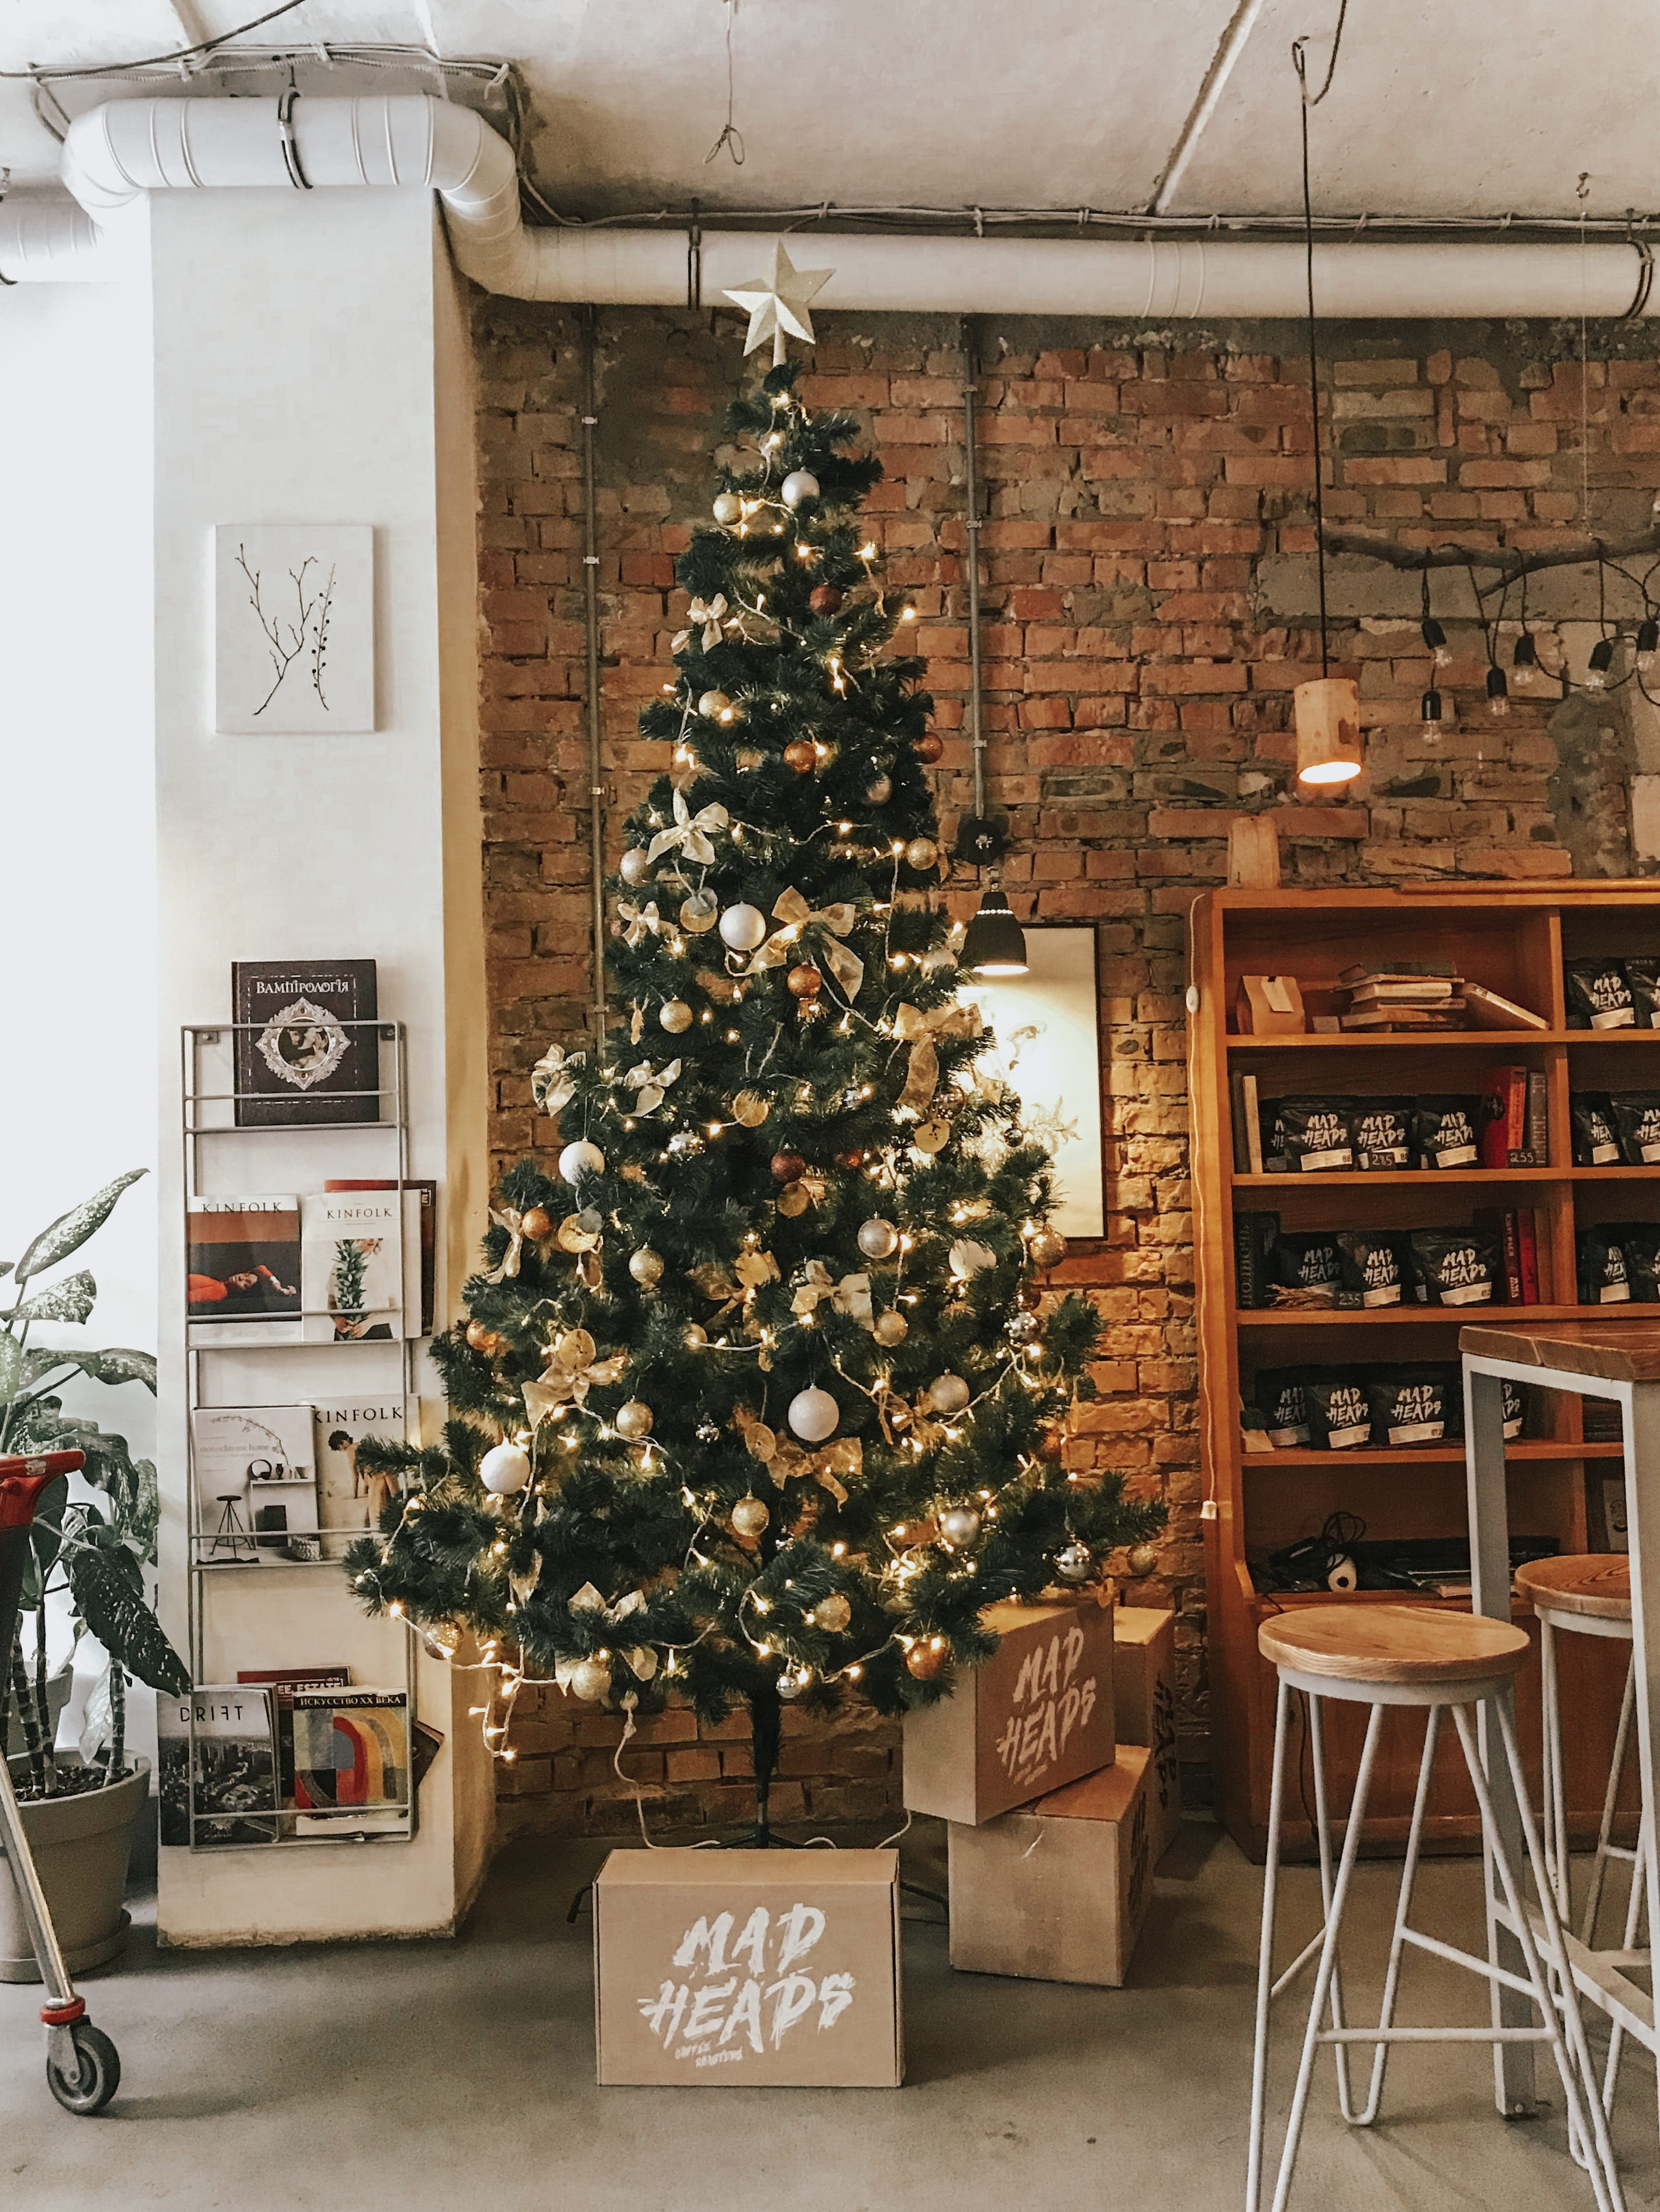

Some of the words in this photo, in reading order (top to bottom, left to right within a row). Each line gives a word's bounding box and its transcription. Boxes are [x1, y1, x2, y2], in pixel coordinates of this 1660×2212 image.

[1307, 1114, 1338, 1129] MAD
[1361, 1114, 1395, 1131] MAD
[1301, 1128, 1347, 1148] HEADS
[1357, 1128, 1405, 1148] HEADS
[1372, 1154, 1393, 1166] 285
[1510, 1152, 1534, 1163] 255
[203, 1202, 281, 1214] KINFOLK
[327, 1208, 392, 1219] KINFOLK
[1304, 1247, 1333, 1264] MAD
[1367, 1249, 1392, 1266] MAD
[1442, 1248, 1475, 1267] MAD
[1438, 1263, 1487, 1285] HEADS
[1339, 1292, 1361, 1305] 235
[1330, 1388, 1360, 1405] MAD
[1398, 1385, 1433, 1402] MAD
[314, 1406, 402, 1423] KINFOLK
[1325, 1403, 1368, 1424] HEADS
[1390, 1400, 1441, 1421] HEADS
[1012, 1626, 1083, 1707] MAD
[301, 1697, 358, 1706] ИСКУССТВО
[180, 1706, 243, 1722] DRIFT
[996, 1676, 1096, 1778] HEADS
[672, 1903, 826, 1978] MAD
[637, 1971, 856, 2053] HEADS
